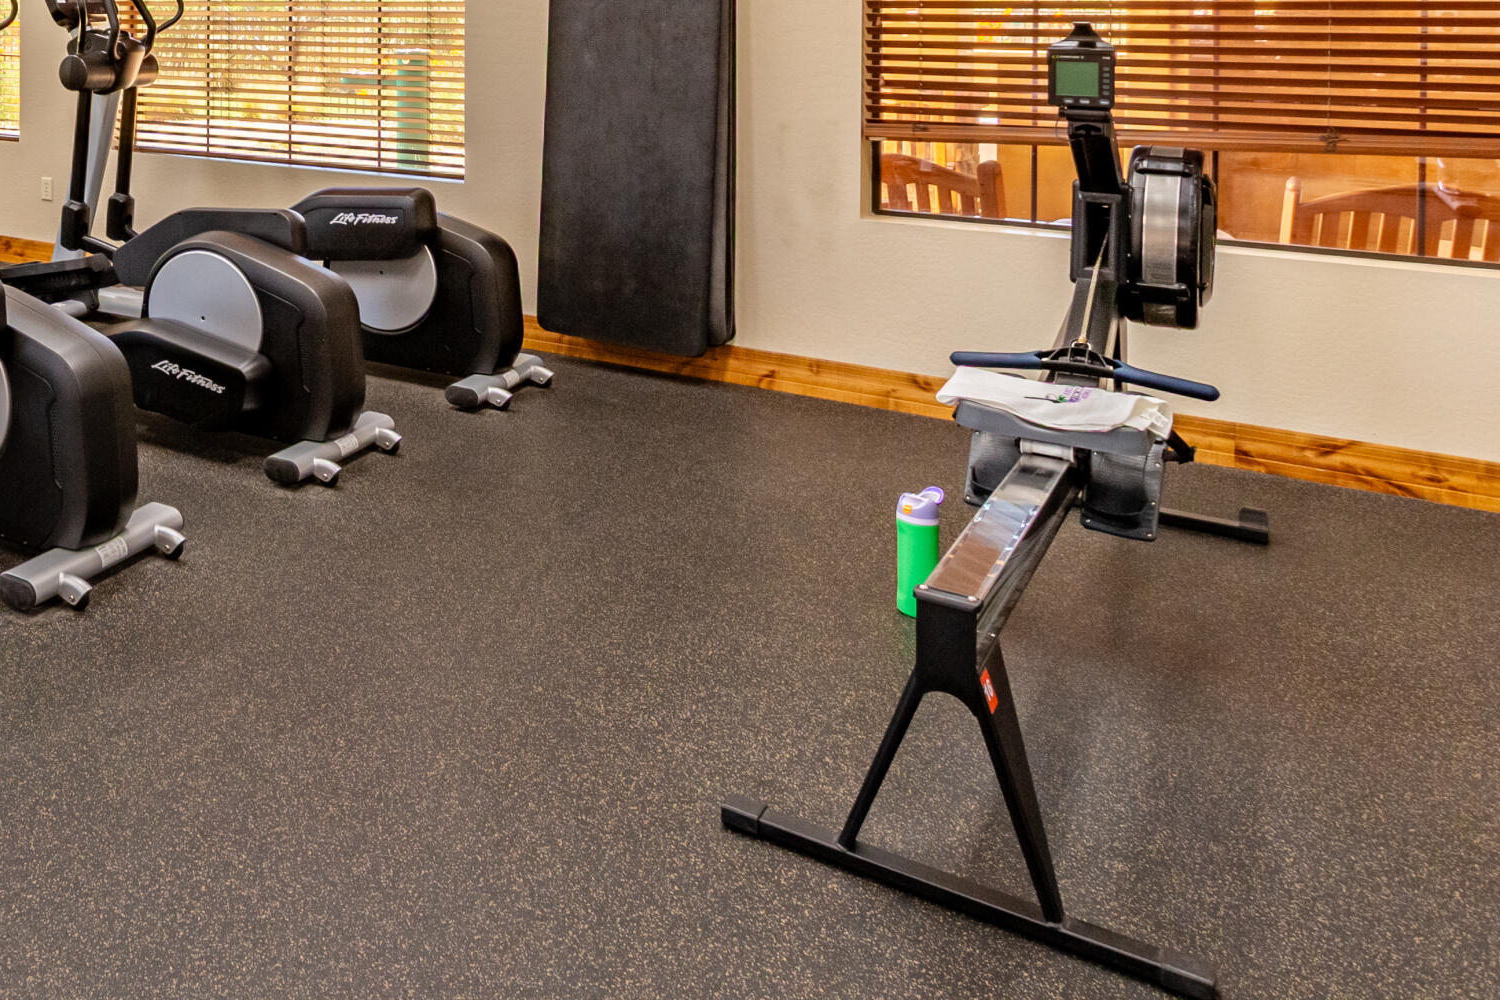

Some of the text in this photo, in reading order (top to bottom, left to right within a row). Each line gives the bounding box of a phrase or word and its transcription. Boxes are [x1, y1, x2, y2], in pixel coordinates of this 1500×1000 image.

[329, 212, 398, 225] Life Fitness
[150, 359, 226, 394] Life Fitness
